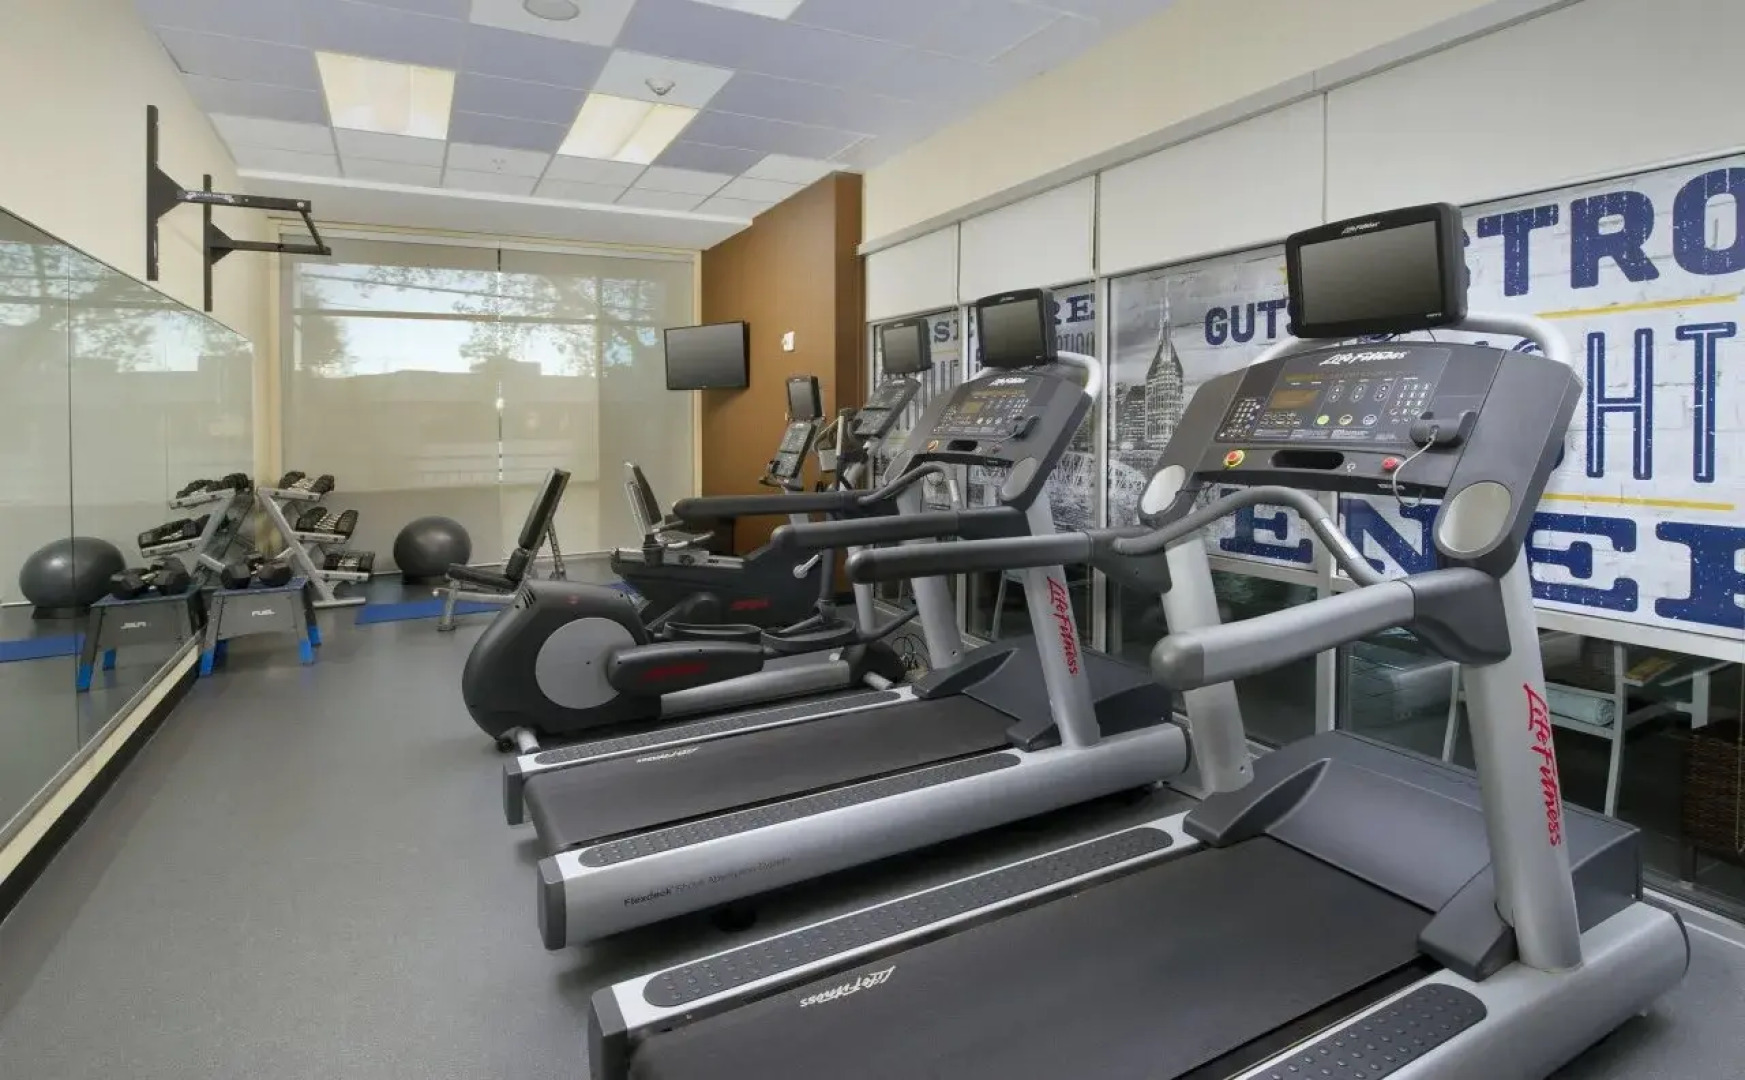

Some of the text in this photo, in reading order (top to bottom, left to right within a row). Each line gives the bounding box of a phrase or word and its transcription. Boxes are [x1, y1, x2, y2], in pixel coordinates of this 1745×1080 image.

[1463, 167, 1745, 297] TRO
[1204, 298, 1293, 346] GUT
[1512, 321, 1737, 484] HT
